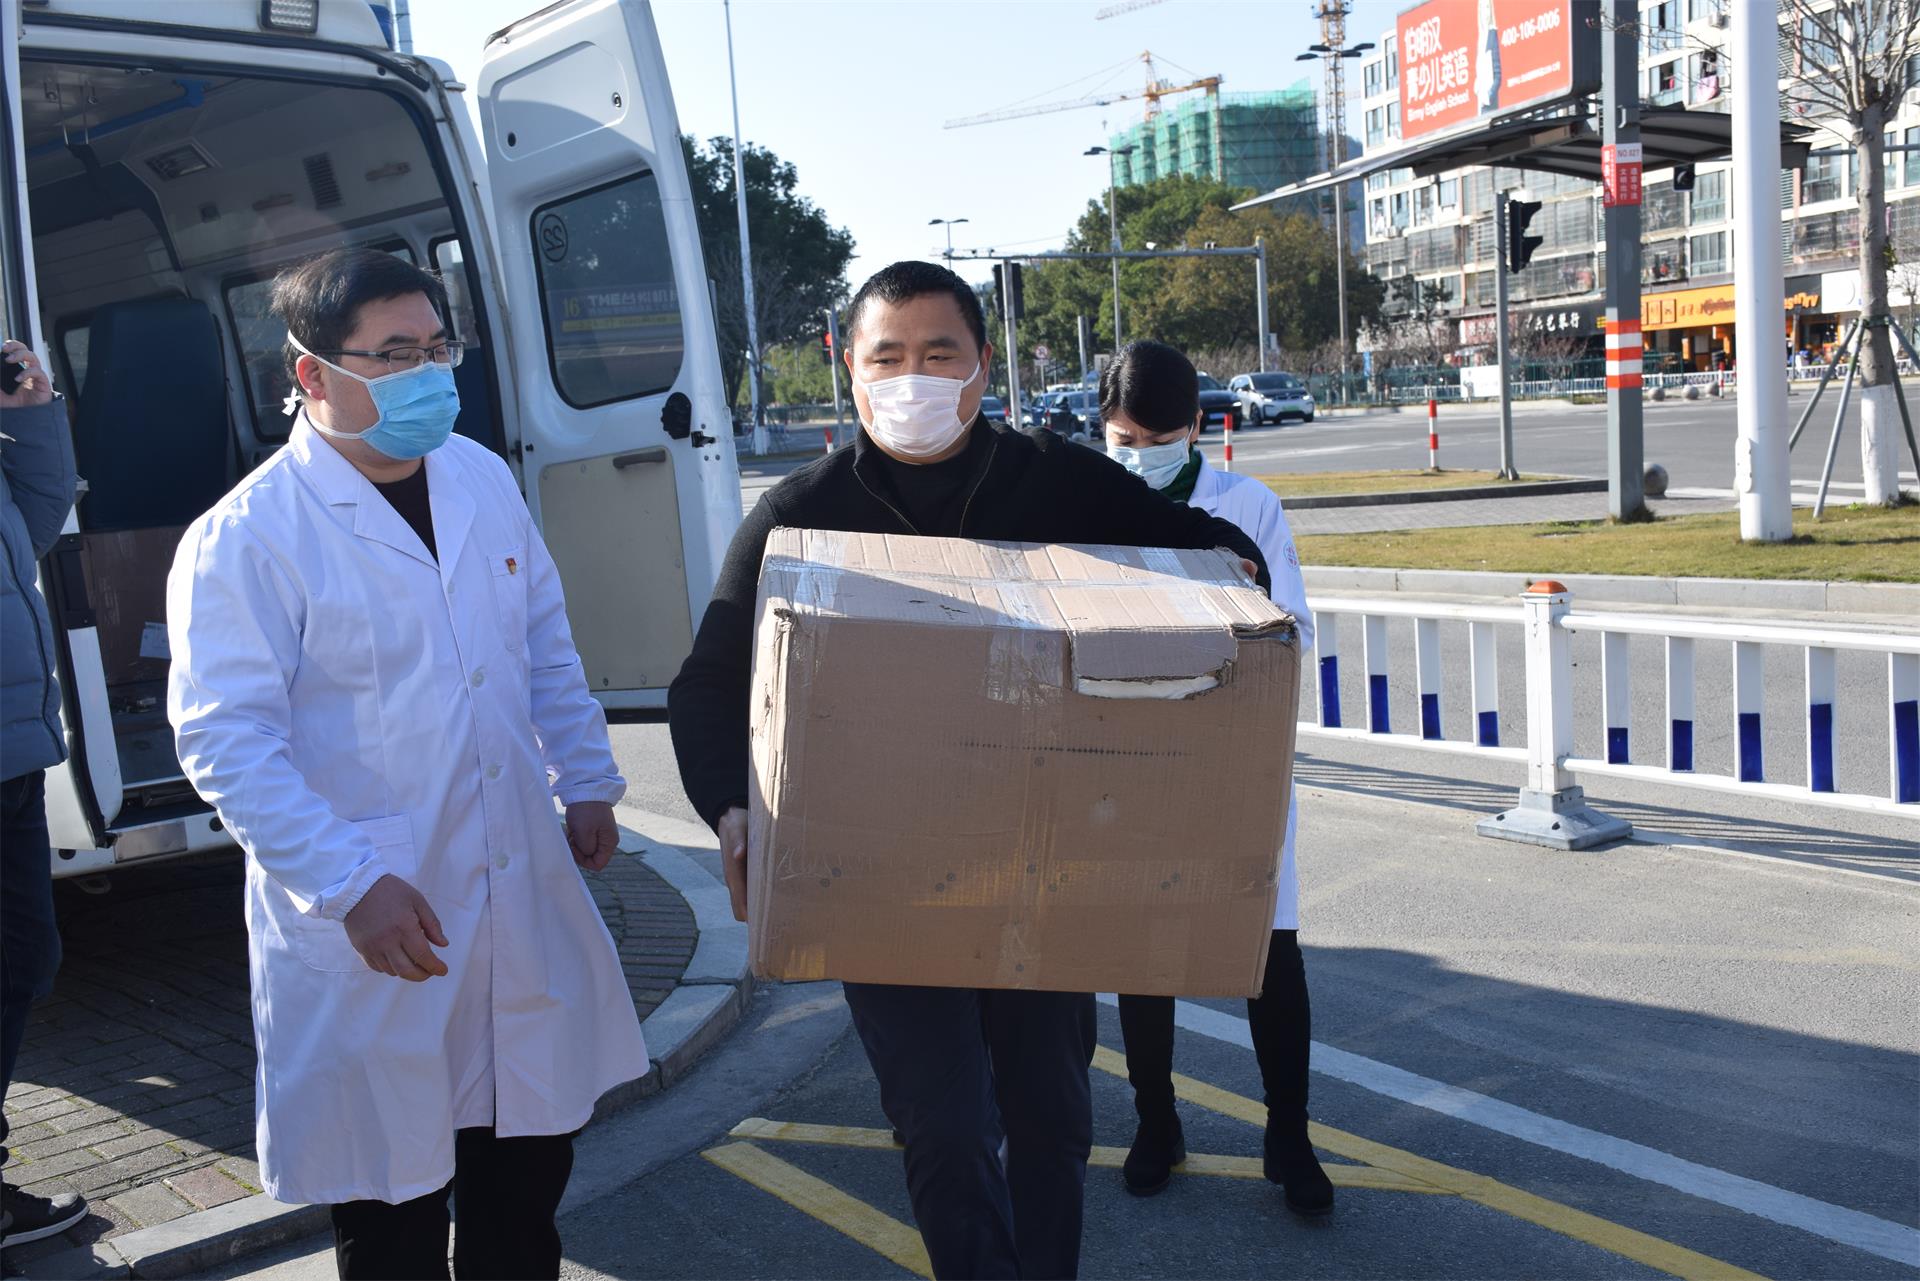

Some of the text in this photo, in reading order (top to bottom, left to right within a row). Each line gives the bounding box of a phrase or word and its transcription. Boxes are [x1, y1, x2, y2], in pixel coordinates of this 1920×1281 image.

[1404, 16, 1442, 64] 伯明汉
[1501, 8, 1560, 47] 400-106-0006
[1406, 47, 1469, 104] 青少儿英语
[1425, 98, 1447, 116] English
[1447, 89, 1470, 107] School
